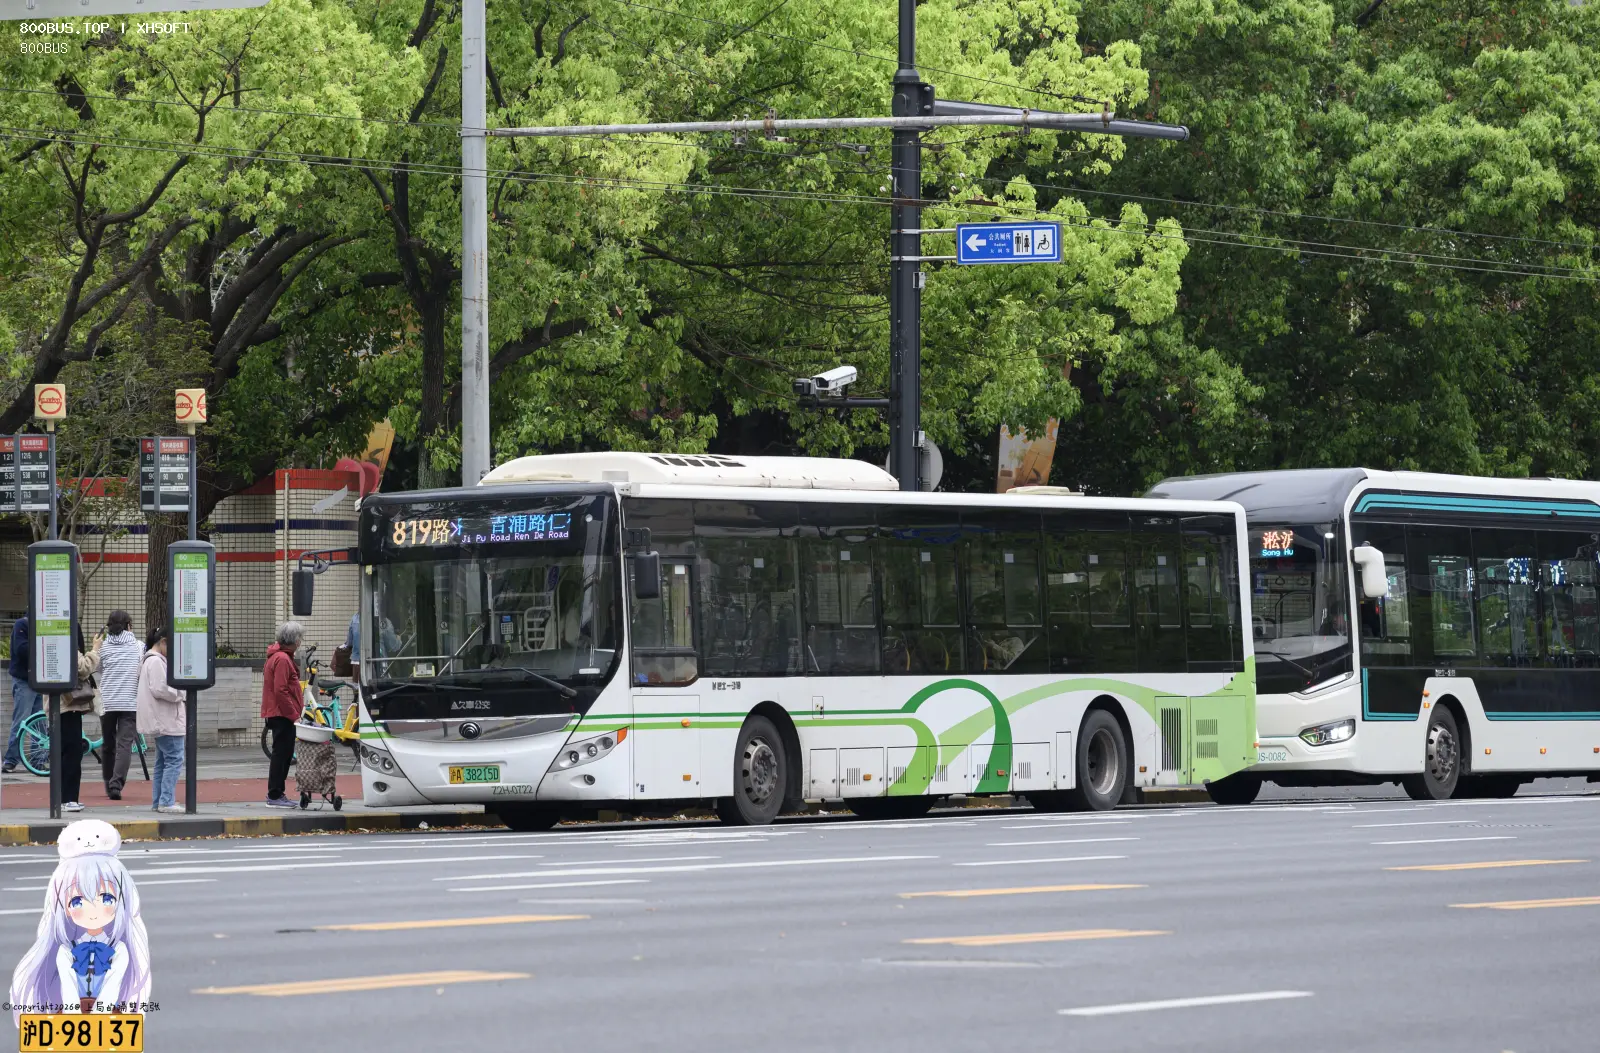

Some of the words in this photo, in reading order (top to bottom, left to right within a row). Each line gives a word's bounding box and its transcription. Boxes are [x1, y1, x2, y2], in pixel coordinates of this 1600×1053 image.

[392, 518, 450, 546] 819路
[461, 534, 471, 543] Ji
[475, 534, 487, 542] Pu
[490, 533, 511, 542] Road
[514, 532, 530, 541] Ren
[533, 531, 544, 540] De
[548, 530, 569, 539] Road
[1262, 549, 1281, 557] Song
[1284, 548, 1294, 556] Hu
